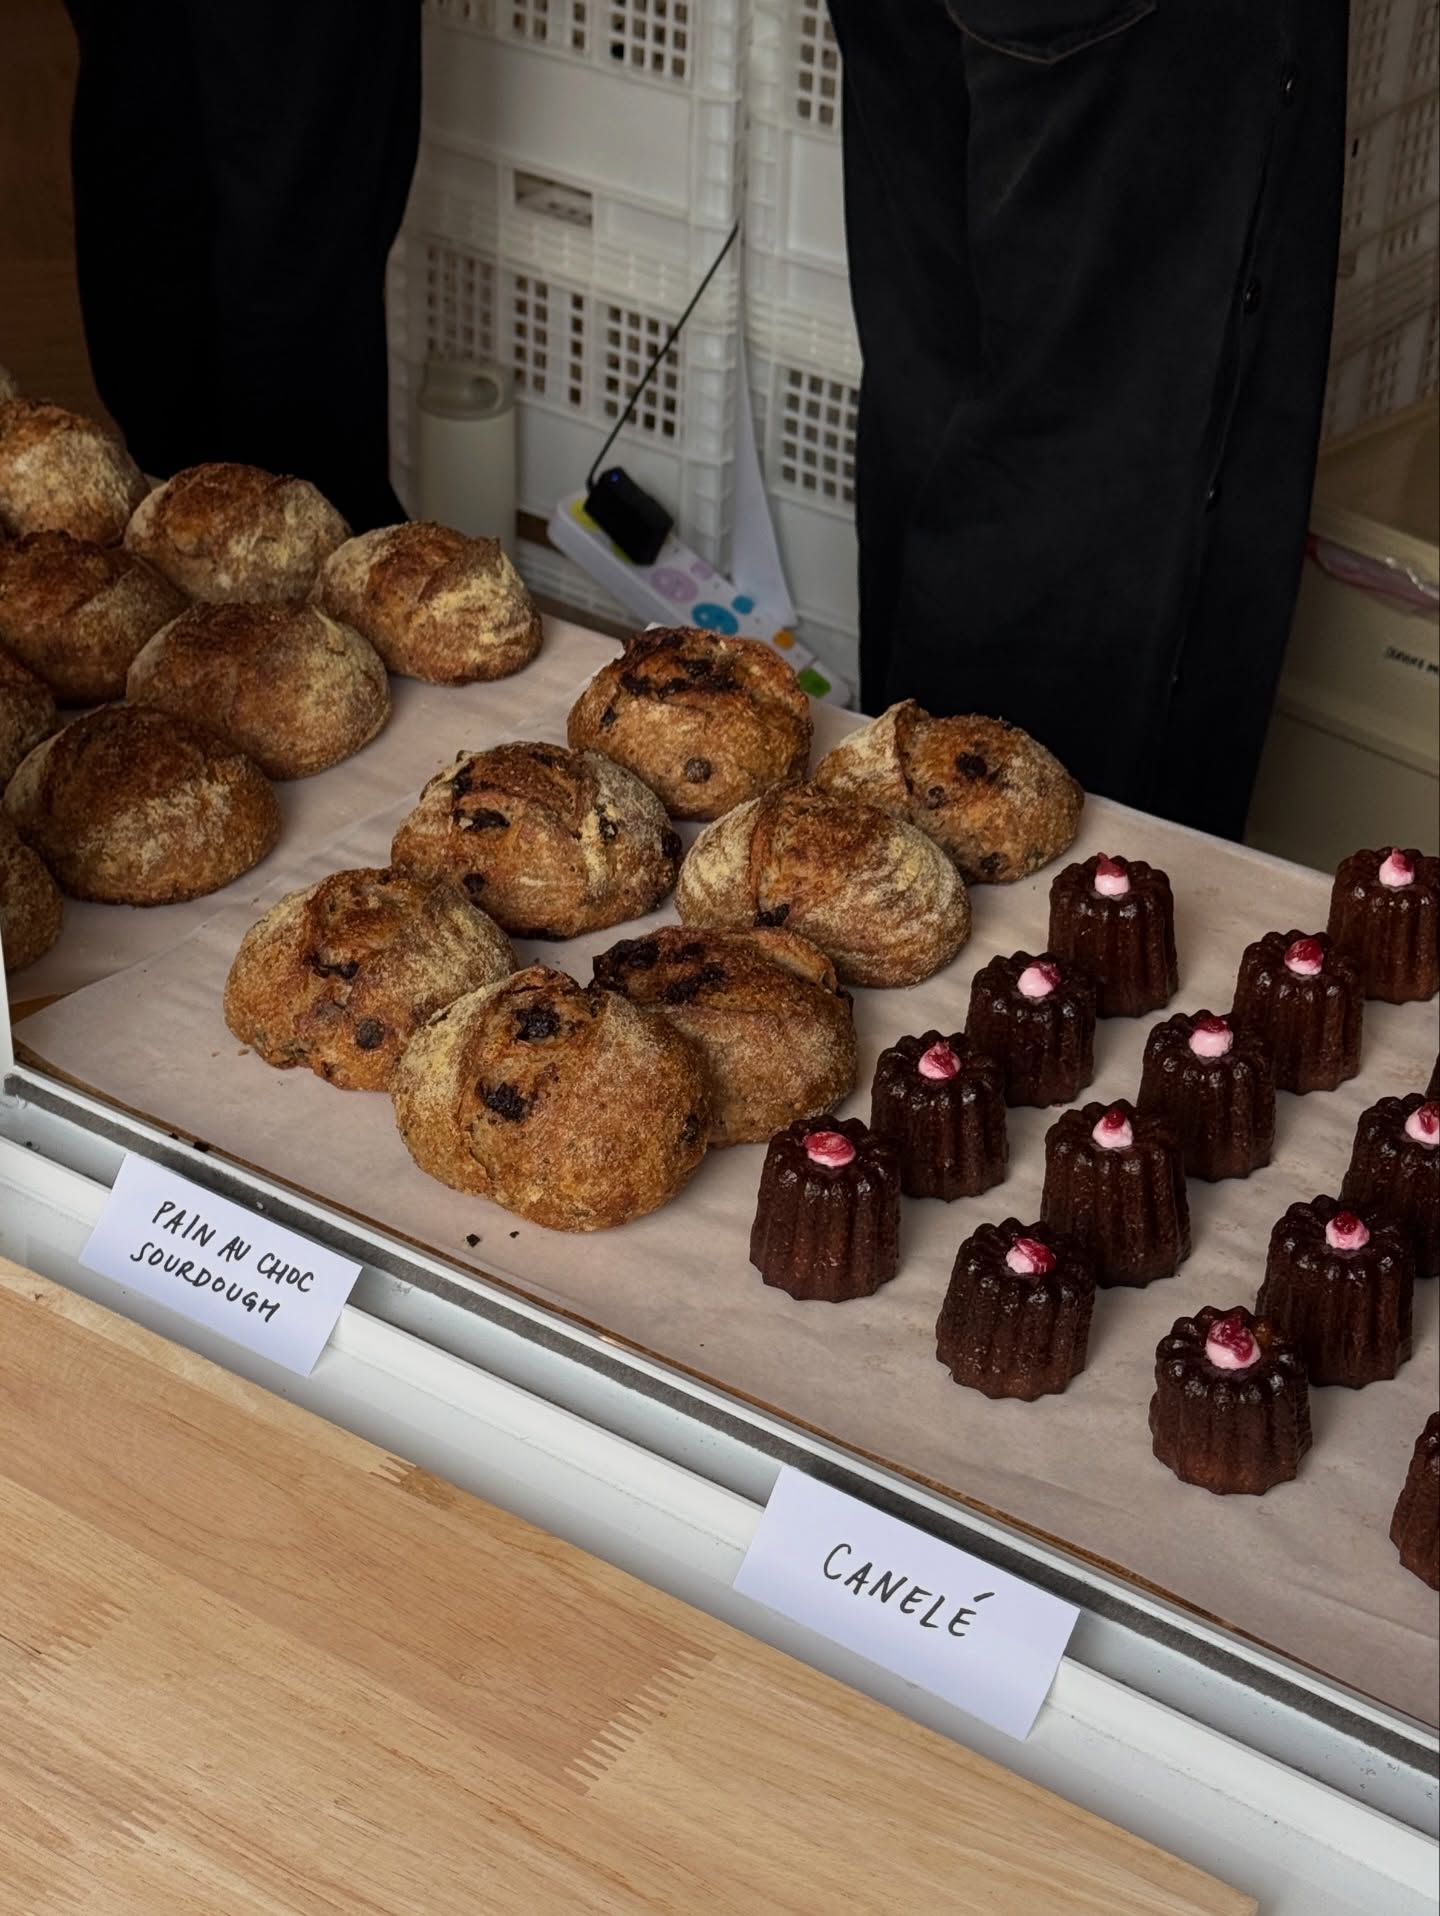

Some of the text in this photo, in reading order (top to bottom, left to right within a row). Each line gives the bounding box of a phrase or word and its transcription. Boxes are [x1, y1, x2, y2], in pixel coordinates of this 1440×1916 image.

[129, 1241, 281, 1323] SOURDOUGH
[151, 1200, 315, 1293] PAIN AU CHOC
[823, 1543, 996, 1638] CANELÉ
